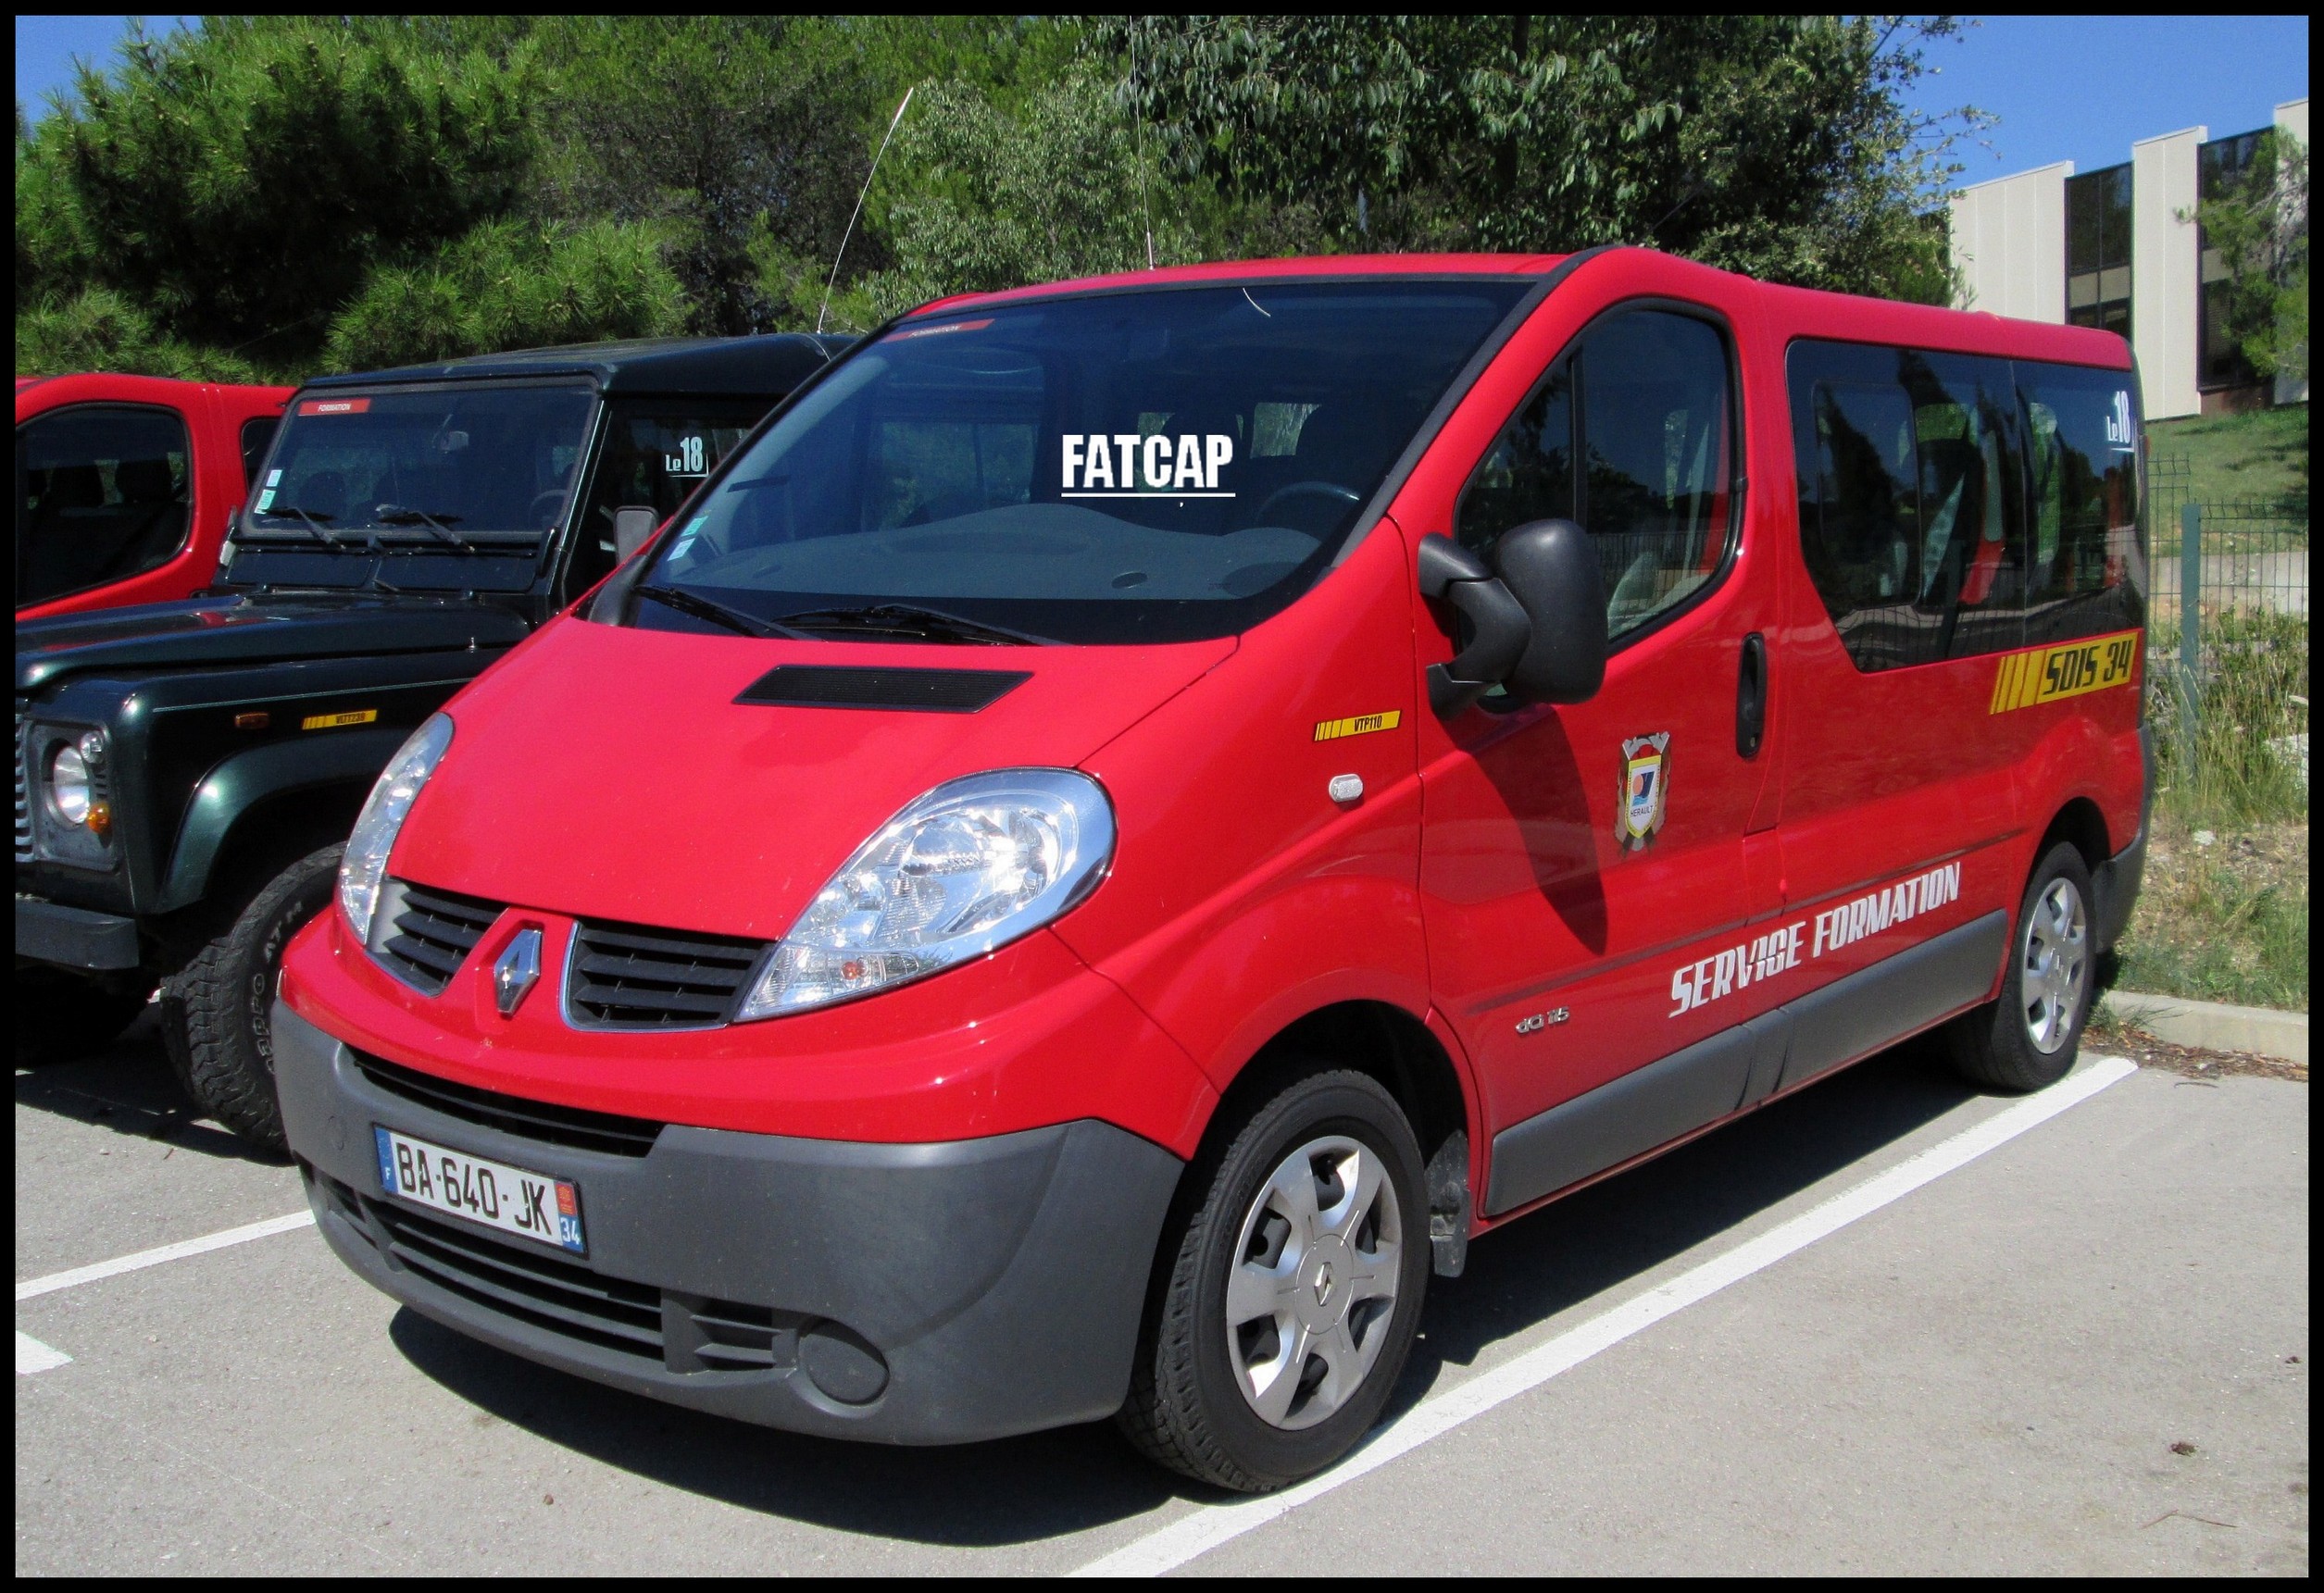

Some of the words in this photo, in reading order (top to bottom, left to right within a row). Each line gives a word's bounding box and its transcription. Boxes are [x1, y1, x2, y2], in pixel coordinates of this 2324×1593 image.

[318, 403, 351, 412] FORMATION
[2106, 416, 2118, 442] Le
[2114, 391, 2131, 444] 18
[665, 454, 681, 472] Le
[680, 436, 704, 472] 18
[2043, 644, 2101, 695] SDIS
[2103, 640, 2133, 682] 34
[1354, 715, 1383, 732] VTP110
[1630, 804, 1654, 817] HERAULT
[1668, 920, 1806, 1018] SERVICE
[1812, 861, 1961, 958] FORMATION
[384, 1166, 391, 1180] F
[395, 1141, 553, 1237] BA-640-JK
[559, 1216, 581, 1245] 34
